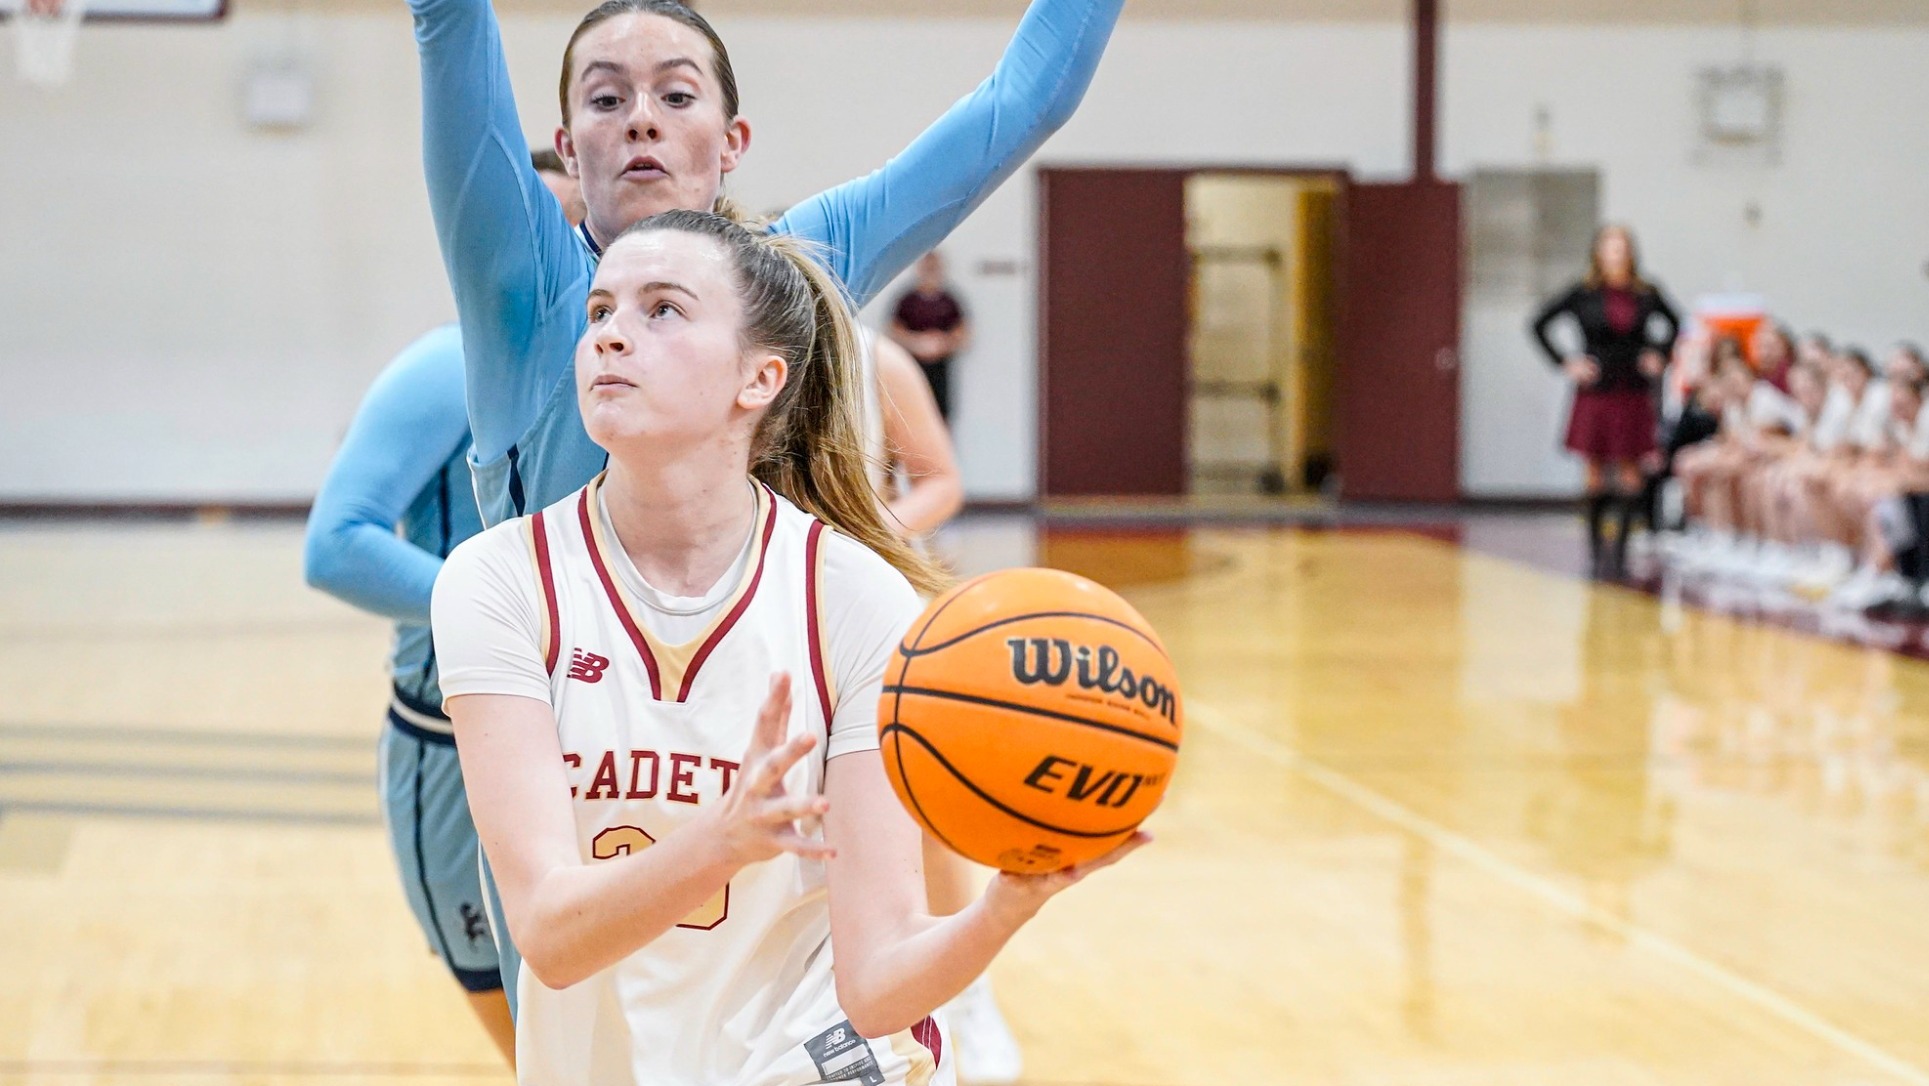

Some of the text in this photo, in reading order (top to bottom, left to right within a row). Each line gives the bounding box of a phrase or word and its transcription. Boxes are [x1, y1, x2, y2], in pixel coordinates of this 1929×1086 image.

[1007, 639, 1177, 727] Wilson
[1023, 755, 1143, 808] EVO
[833, 1039, 856, 1052] balance
